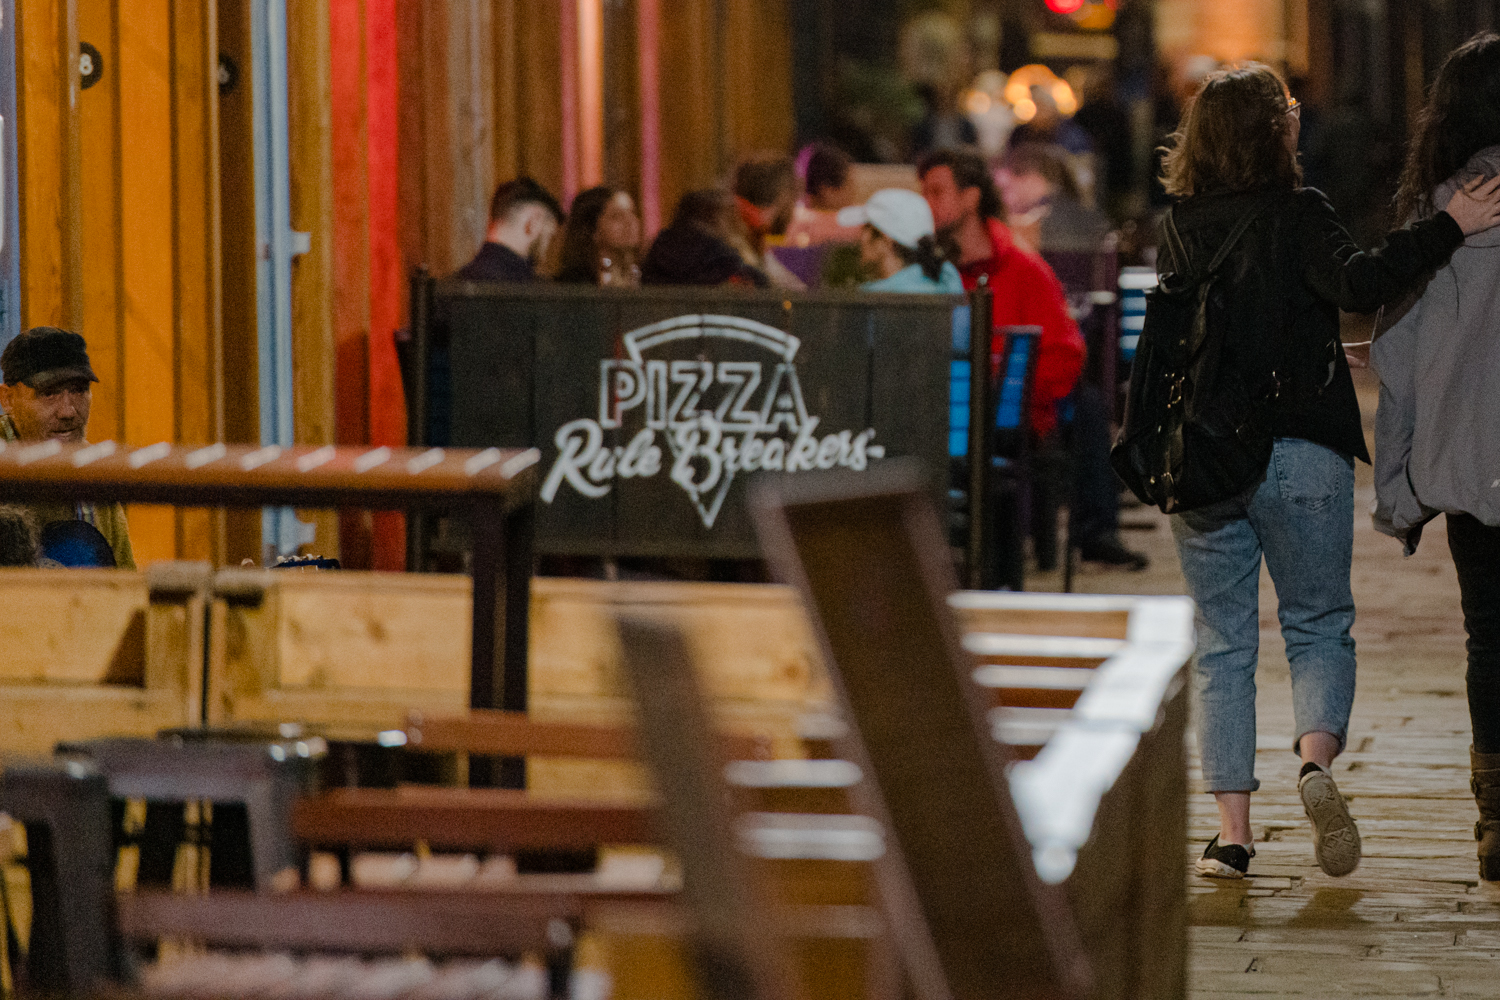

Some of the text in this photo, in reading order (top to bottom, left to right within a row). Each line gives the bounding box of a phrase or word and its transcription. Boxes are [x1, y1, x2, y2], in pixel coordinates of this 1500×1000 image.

[600, 359, 808, 431] PIZZA
[540, 415, 885, 503] Rule Breakers
